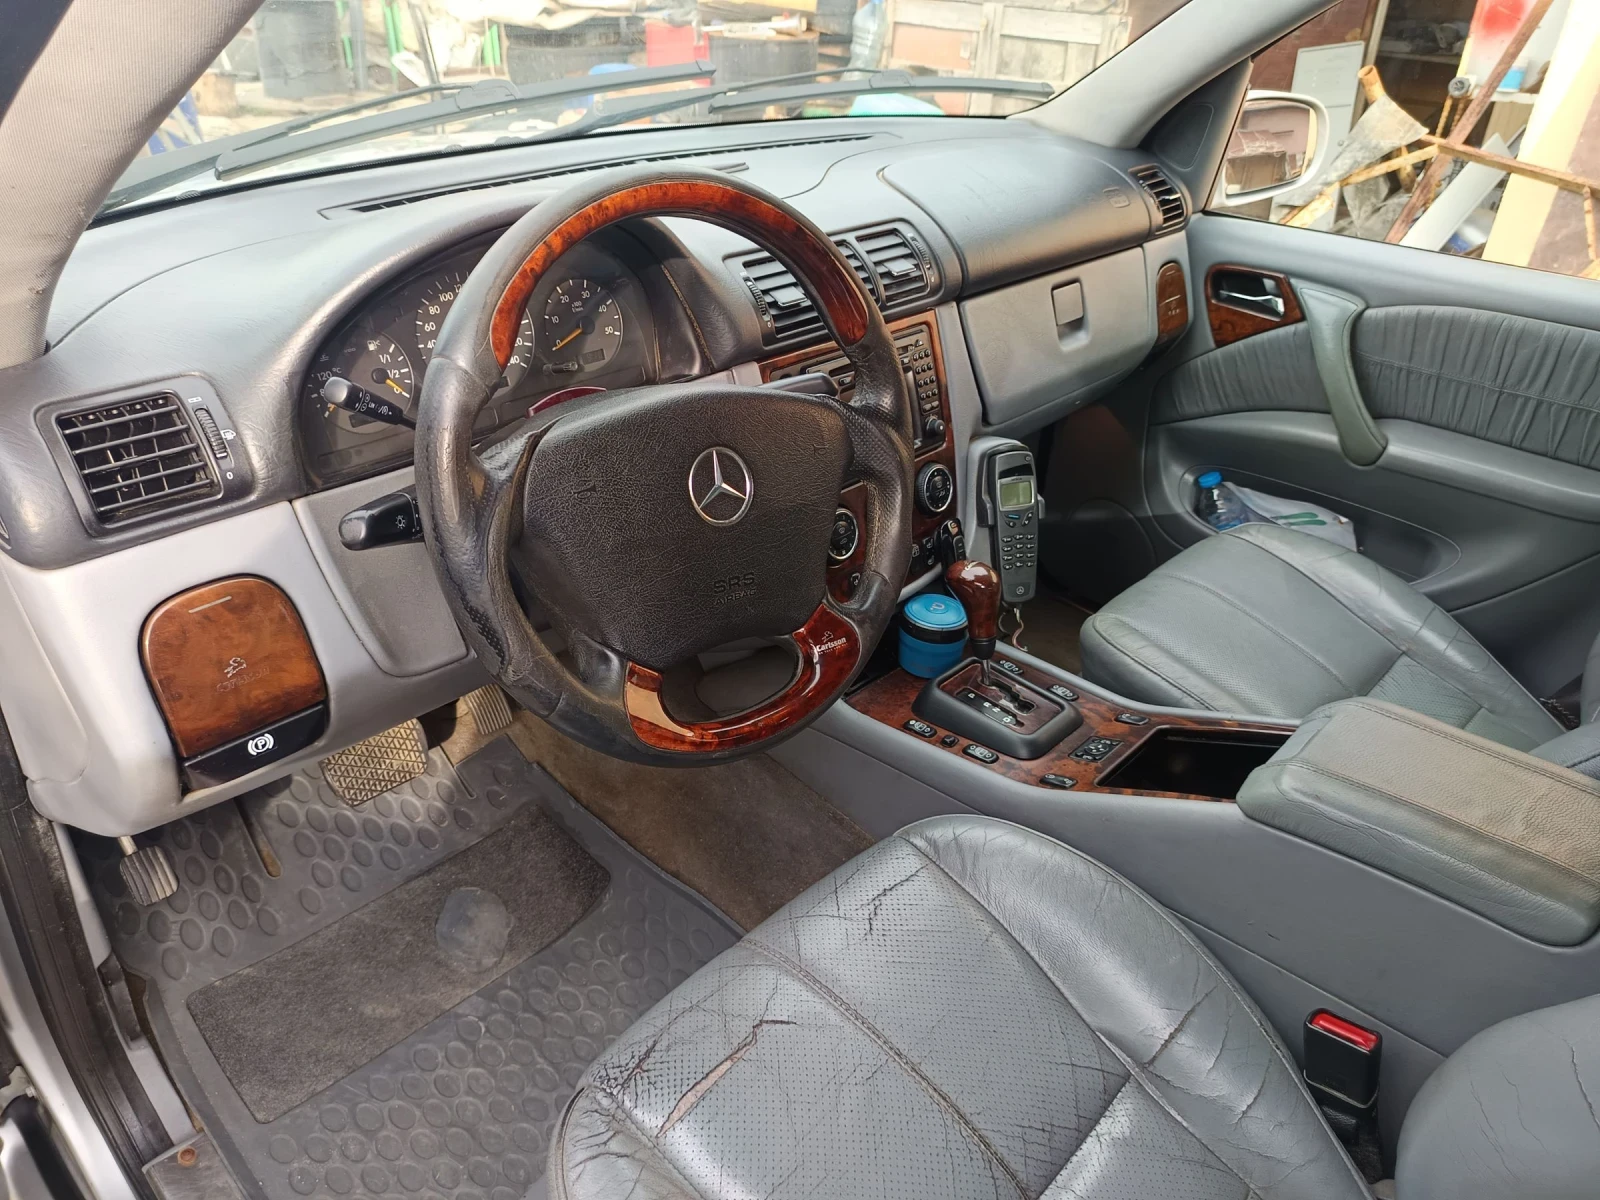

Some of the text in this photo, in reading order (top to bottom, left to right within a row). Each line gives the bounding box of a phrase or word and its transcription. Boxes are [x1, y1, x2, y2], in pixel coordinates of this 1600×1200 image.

[439, 291, 453, 302] 100
[560, 294, 570, 303] 20
[581, 290, 591, 299] 30
[428, 305, 441, 315] 80
[598, 304, 607, 315] 40
[551, 315, 560, 324] 10
[424, 321, 436, 332] 60
[604, 325, 614, 335] 50
[379, 353, 391, 364] 1/1
[317, 370, 332, 381] 120
[387, 369, 400, 378] 1/2
[714, 571, 755, 594] SRS
[816, 637, 847, 652] Carlsson
